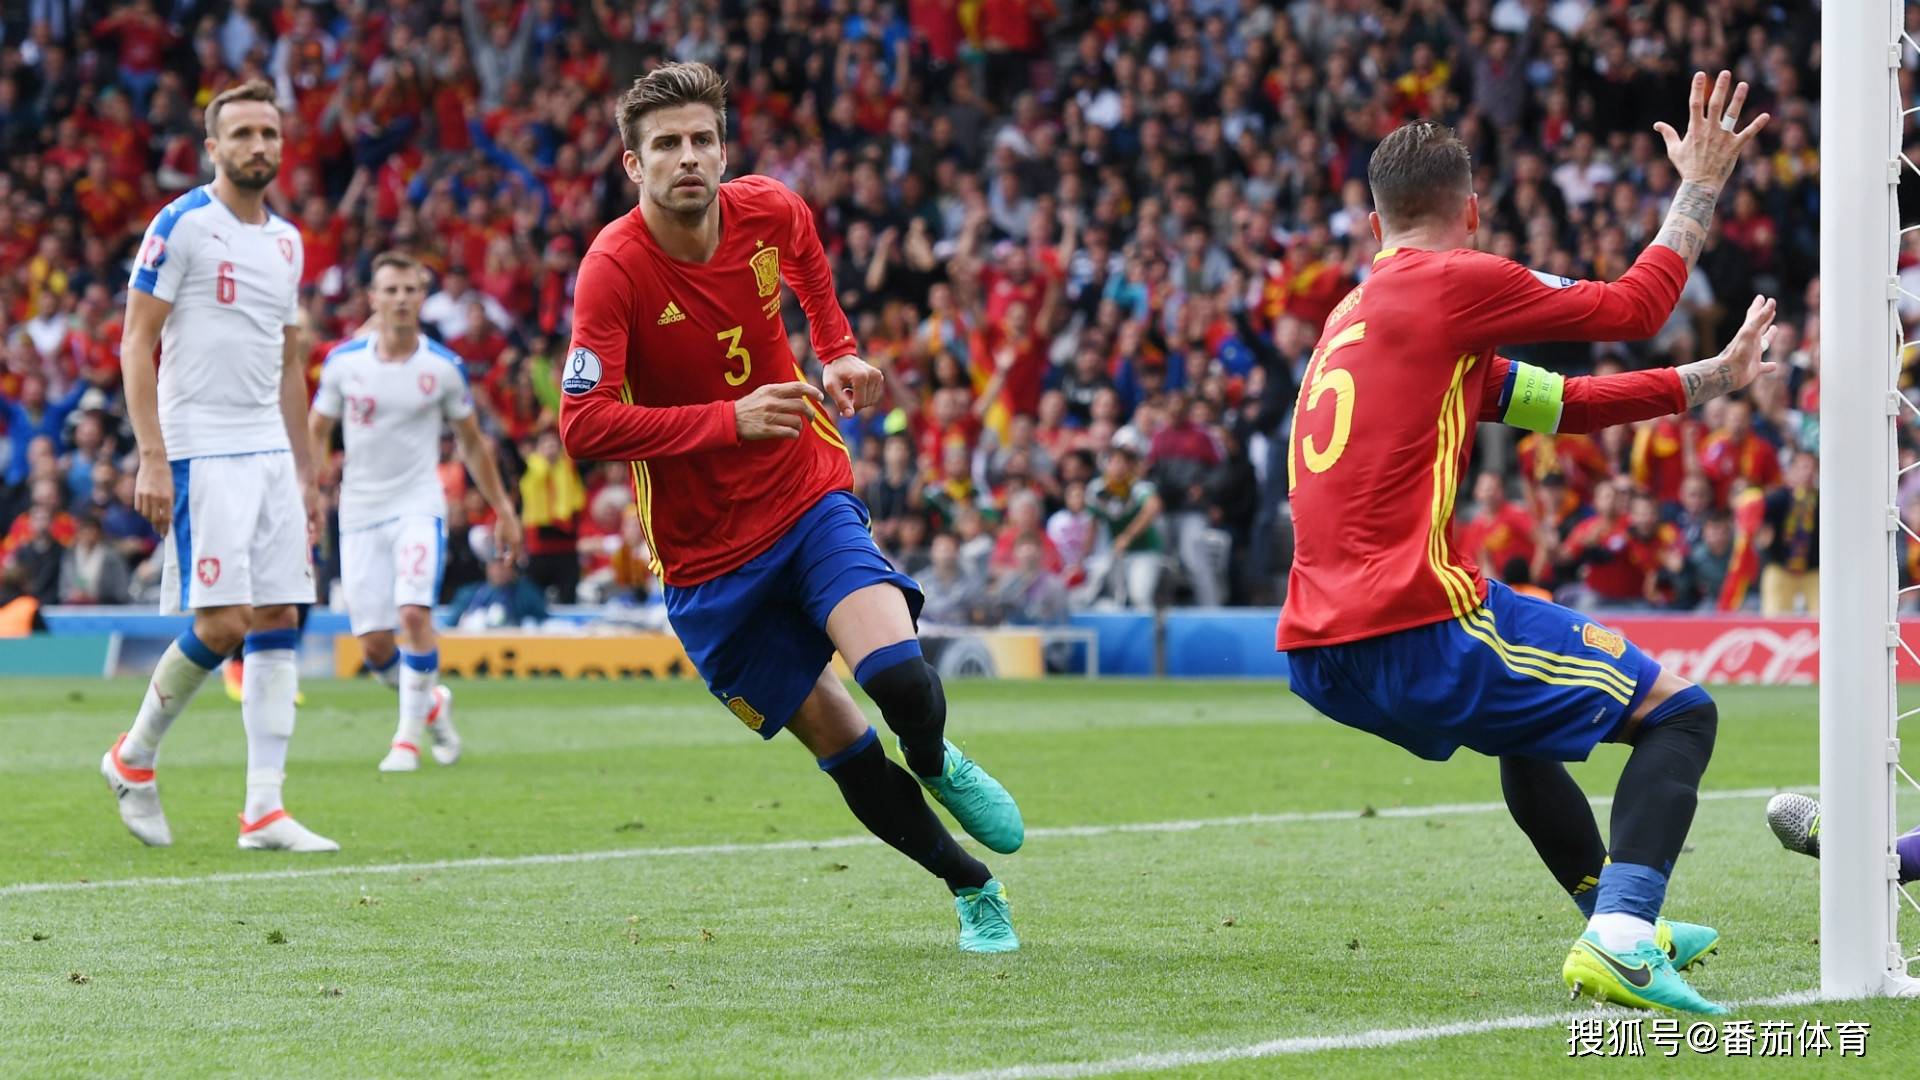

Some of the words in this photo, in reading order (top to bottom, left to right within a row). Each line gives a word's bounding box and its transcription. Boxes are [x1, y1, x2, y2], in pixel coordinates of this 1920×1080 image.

[217, 261, 236, 304] 6
[657, 313, 686, 325] adidas
[717, 325, 752, 386] 3
